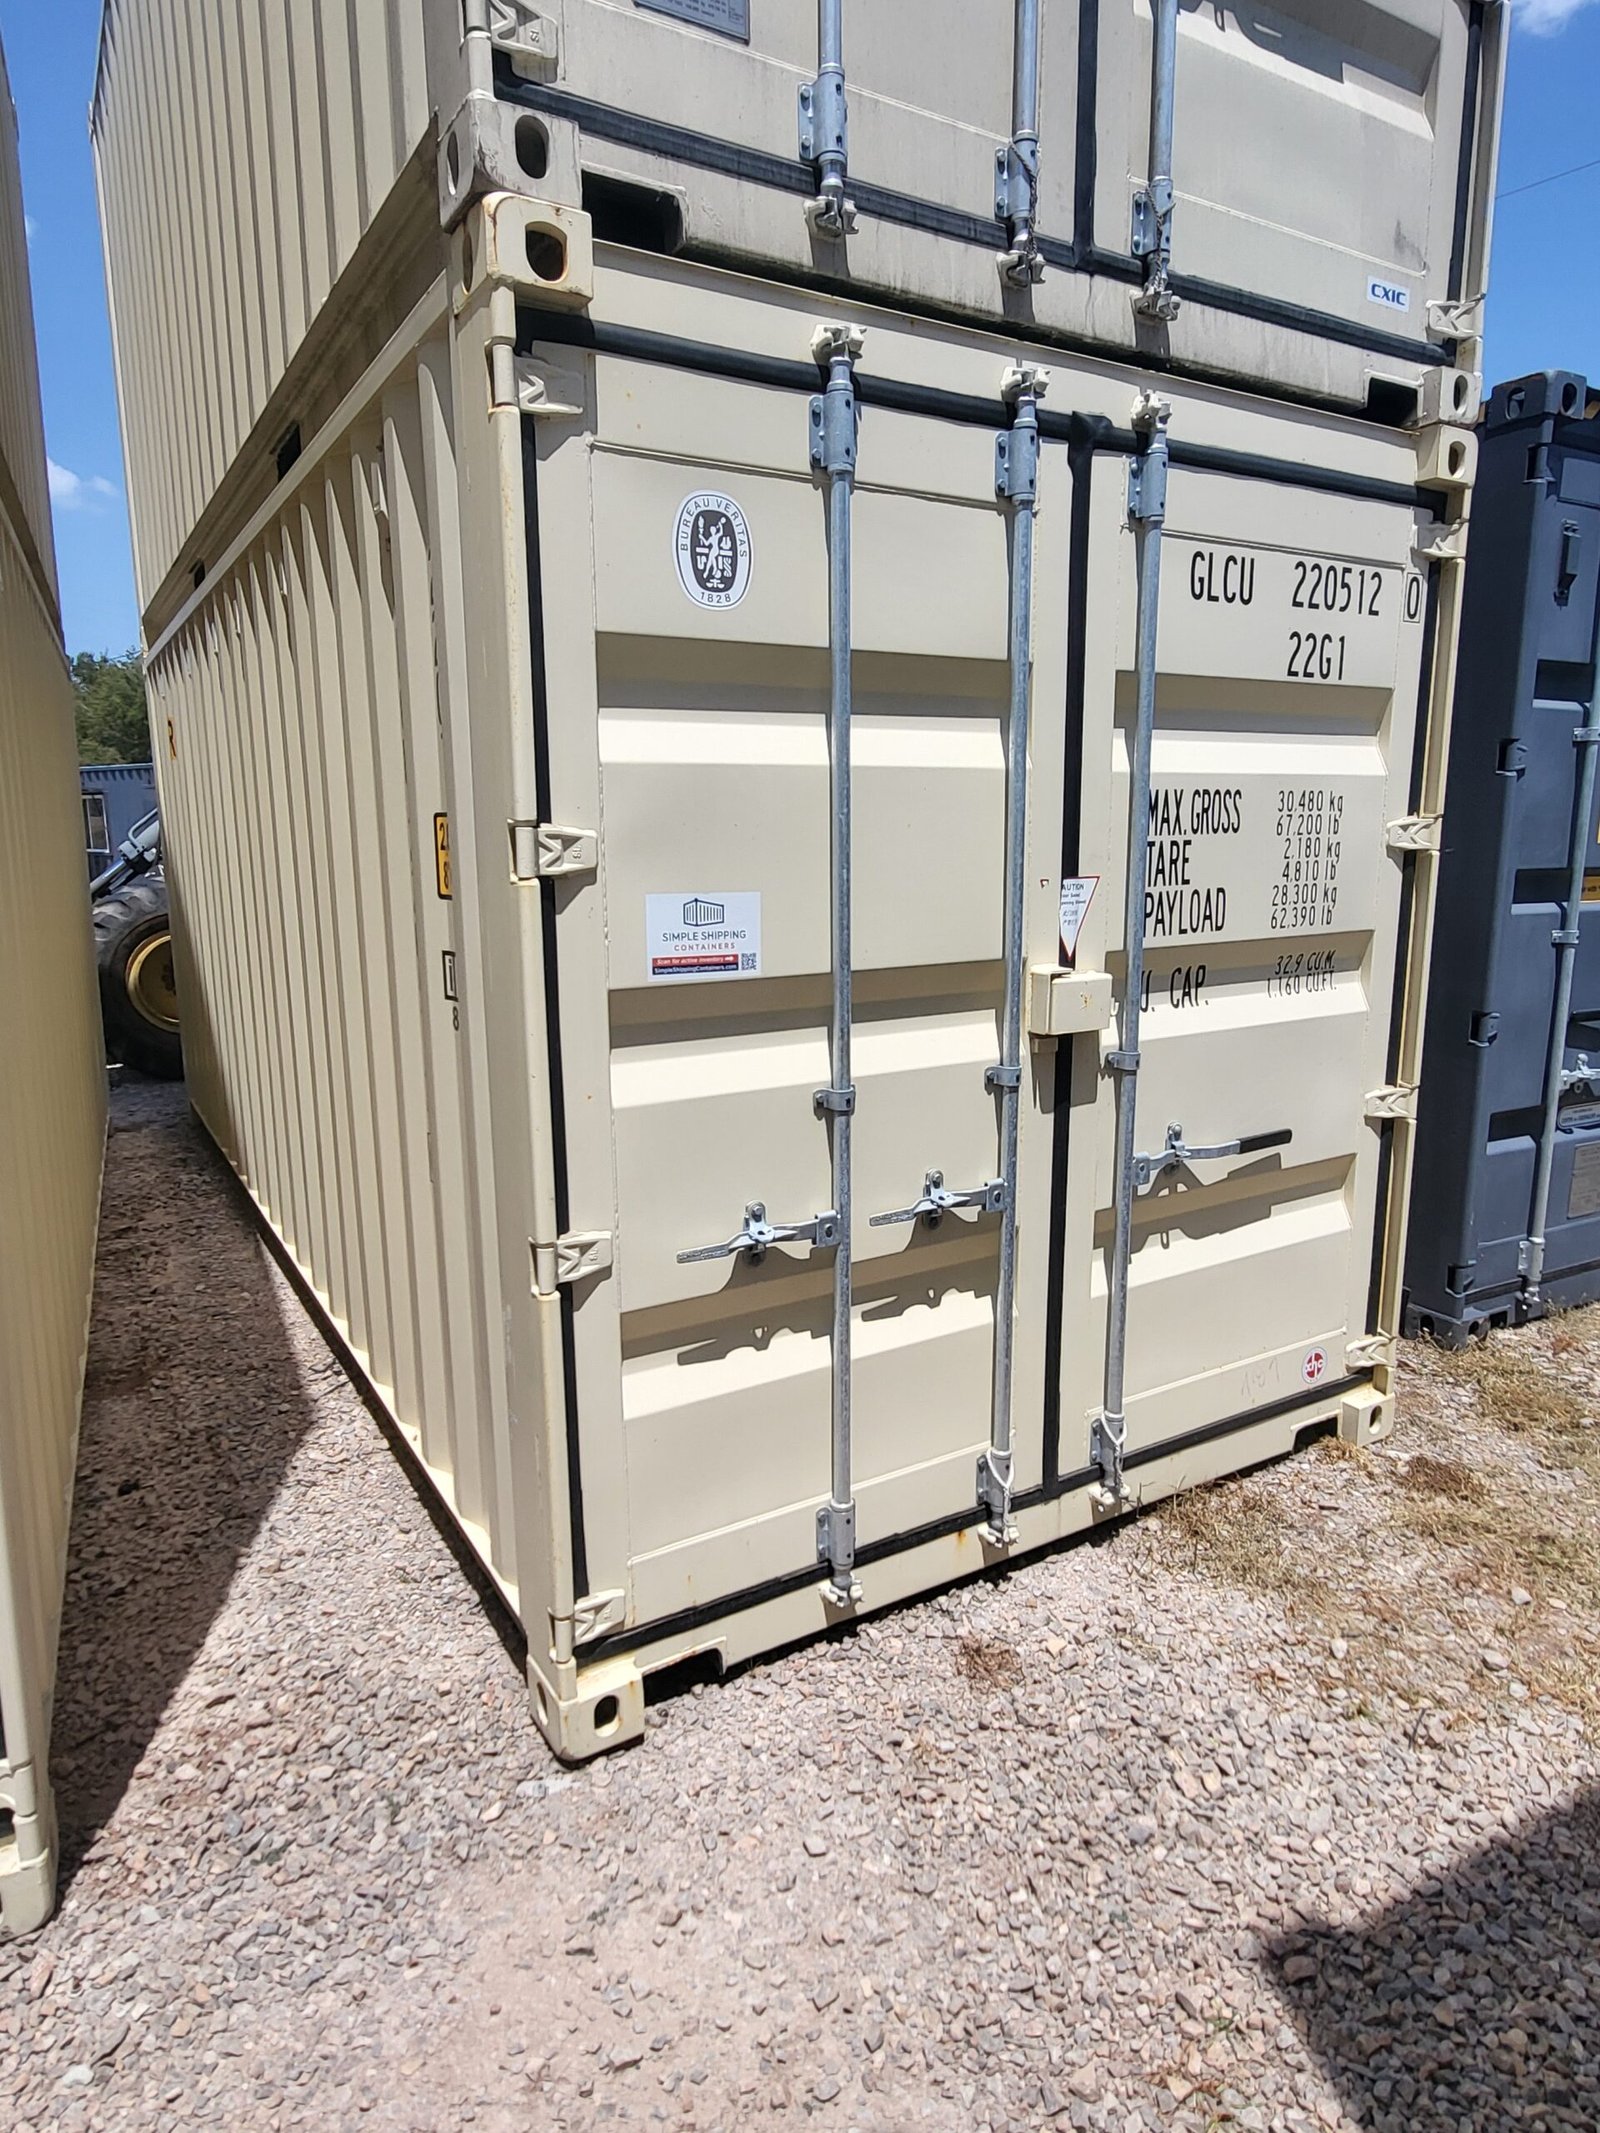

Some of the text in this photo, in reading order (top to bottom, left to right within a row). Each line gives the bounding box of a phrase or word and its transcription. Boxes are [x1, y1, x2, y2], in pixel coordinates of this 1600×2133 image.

[1371, 283, 1406, 306] CXIC
[680, 498, 747, 557] BUREAU VERITAS
[1190, 551, 1255, 605] GLCU
[1291, 560, 1383, 616] 220512
[700, 591, 731, 603] 1828
[1287, 631, 1346, 680] 22G1
[1329, 790, 1344, 818] kg
[1328, 813, 1339, 835] lb
[1147, 839, 1192, 887] TARE
[1326, 836, 1341, 864] kg
[1324, 859, 1336, 880] lb
[1143, 887, 1226, 938] PAYLOAD
[1323, 882, 1337, 909] kg
[1321, 904, 1332, 926] lb
[662, 930, 746, 942] SIMPLE SHIPPING
[674, 942, 735, 952] CONTAINERS
[1140, 949, 1337, 1012] U. CAP. 32.9 CU.M.
[1306, 969, 1337, 992] CU.FT.
